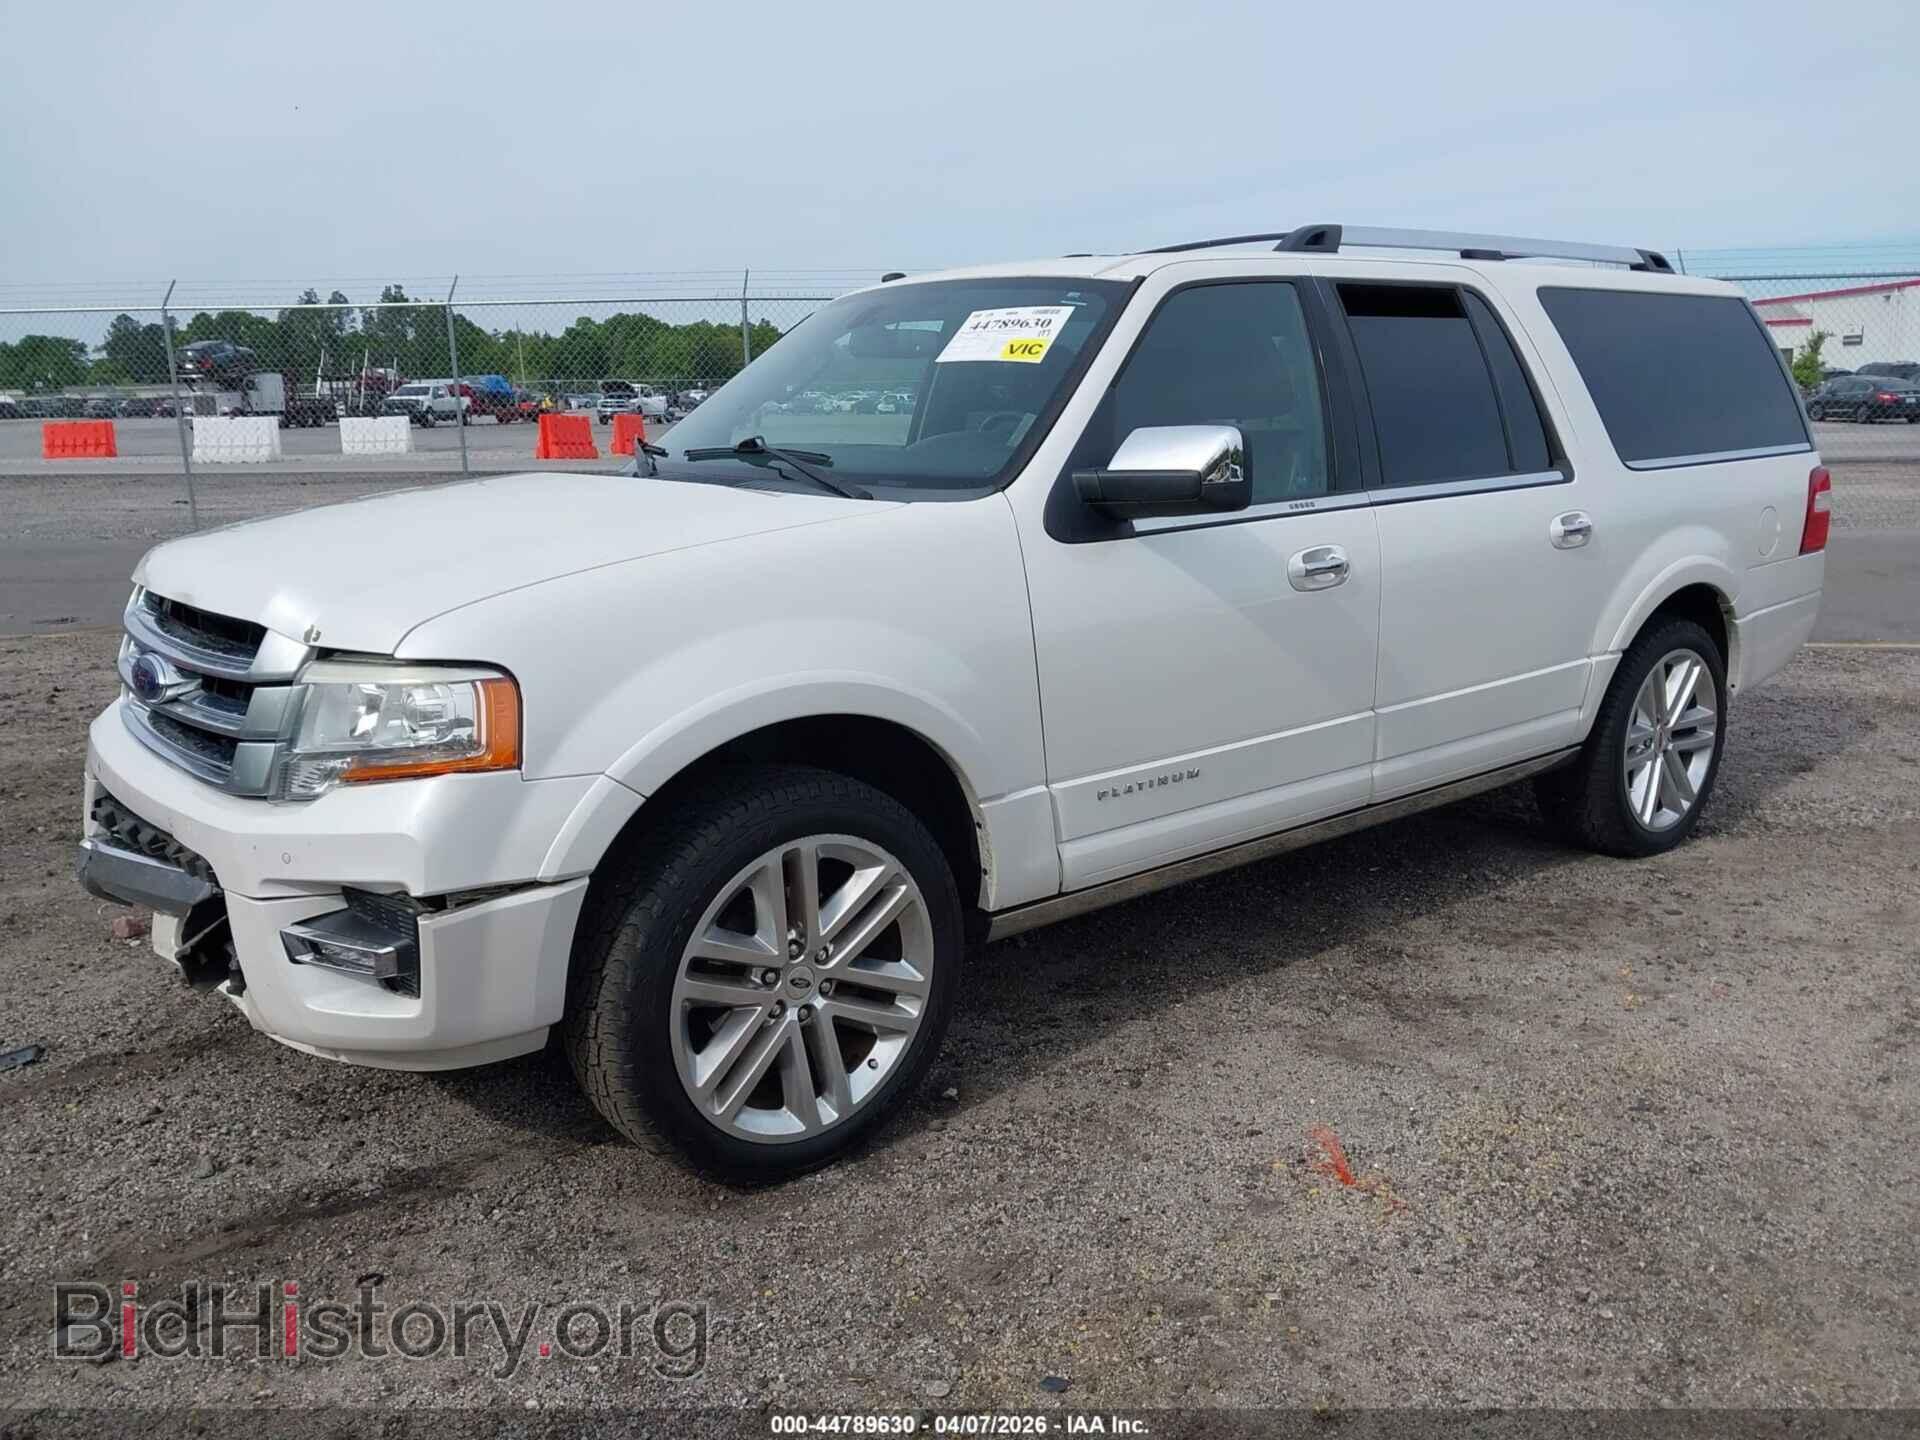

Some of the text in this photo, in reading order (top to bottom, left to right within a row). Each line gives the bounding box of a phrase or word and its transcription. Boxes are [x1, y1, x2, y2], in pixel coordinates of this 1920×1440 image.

[969, 317, 1053, 331] 44789630
[1008, 343, 1043, 356] VIC
[1096, 767, 1200, 801] PLATINUM
